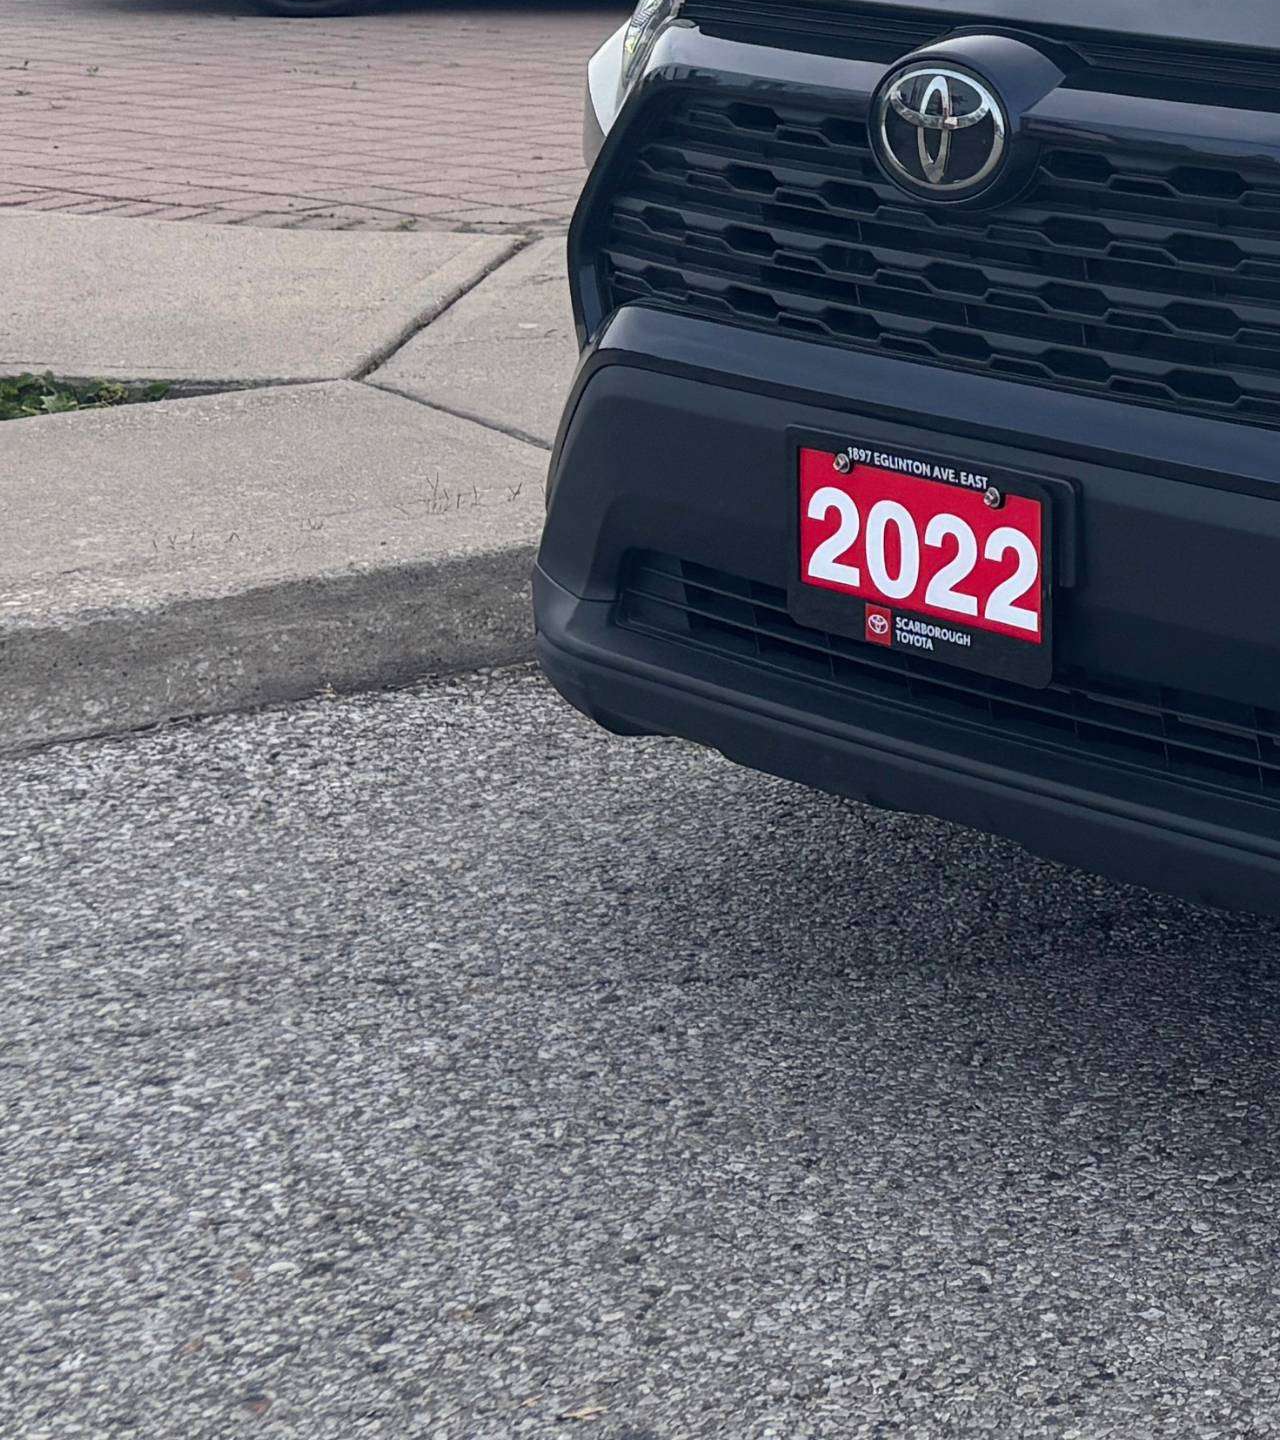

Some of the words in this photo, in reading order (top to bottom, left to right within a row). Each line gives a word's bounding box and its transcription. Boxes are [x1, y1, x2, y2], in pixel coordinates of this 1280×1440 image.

[847, 447, 872, 462] 1897
[873, 452, 931, 477] EGLINTON
[933, 466, 959, 483] AVE.
[961, 471, 988, 489] EAST
[807, 486, 1039, 632] 2022
[895, 616, 971, 647] SCARBOROUGH
[895, 629, 934, 651] TOYOTA
